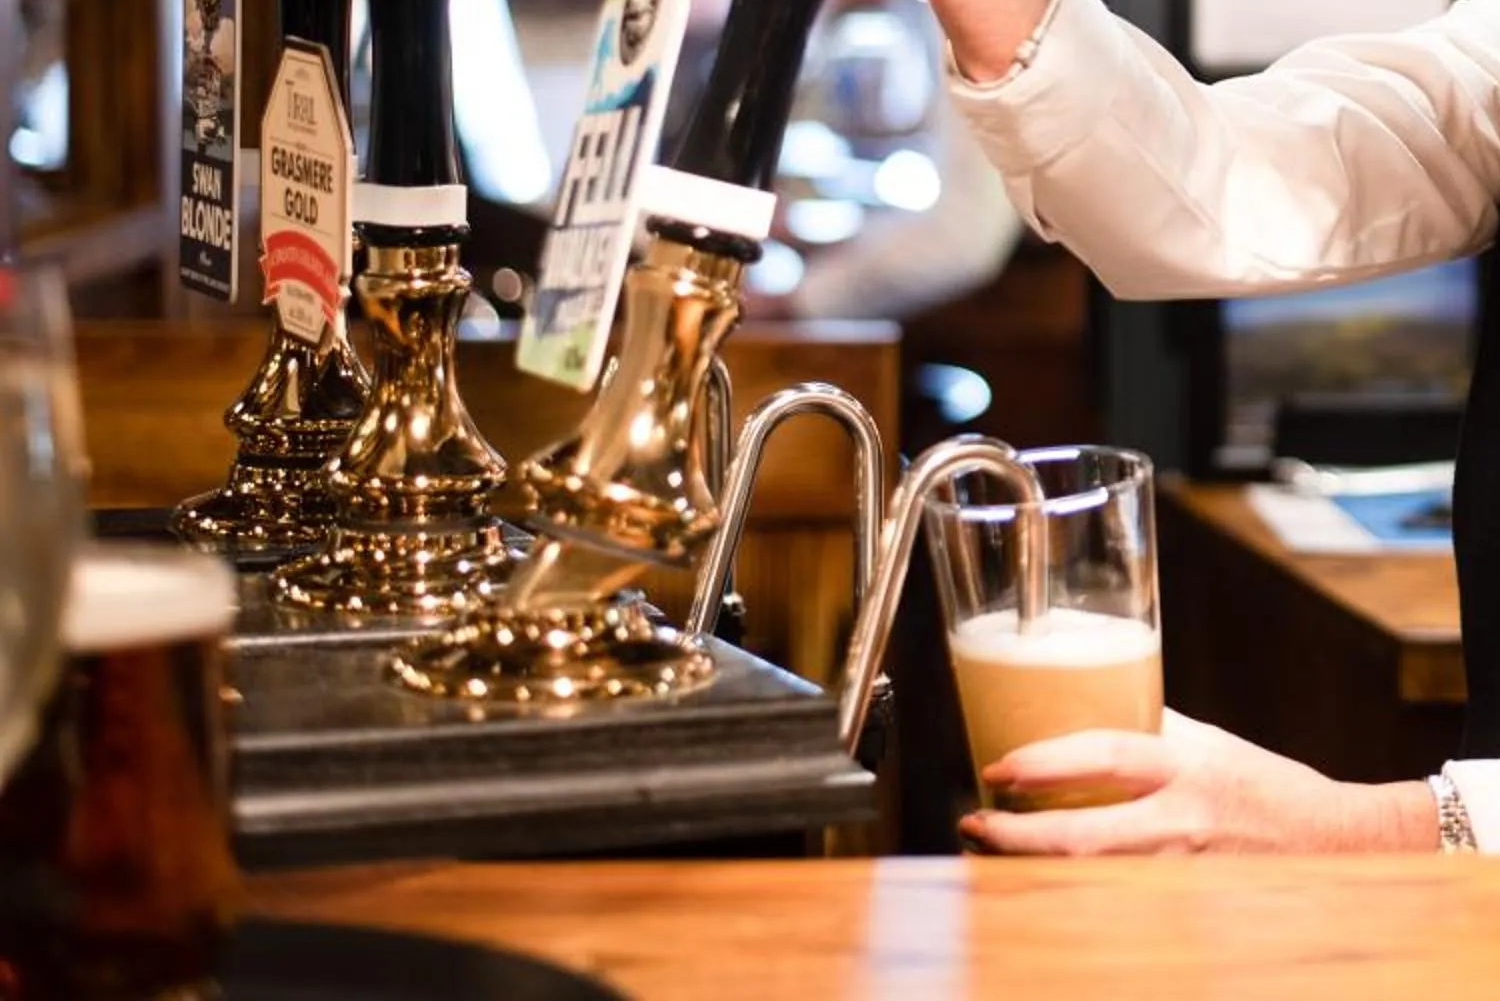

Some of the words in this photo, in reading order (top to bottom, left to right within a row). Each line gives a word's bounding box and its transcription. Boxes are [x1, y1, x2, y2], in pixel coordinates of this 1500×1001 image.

[192, 161, 222, 199] SWAN
[272, 146, 333, 195] GRASMERE
[181, 195, 231, 250] BLONDE
[285, 187, 318, 225] GOLD
